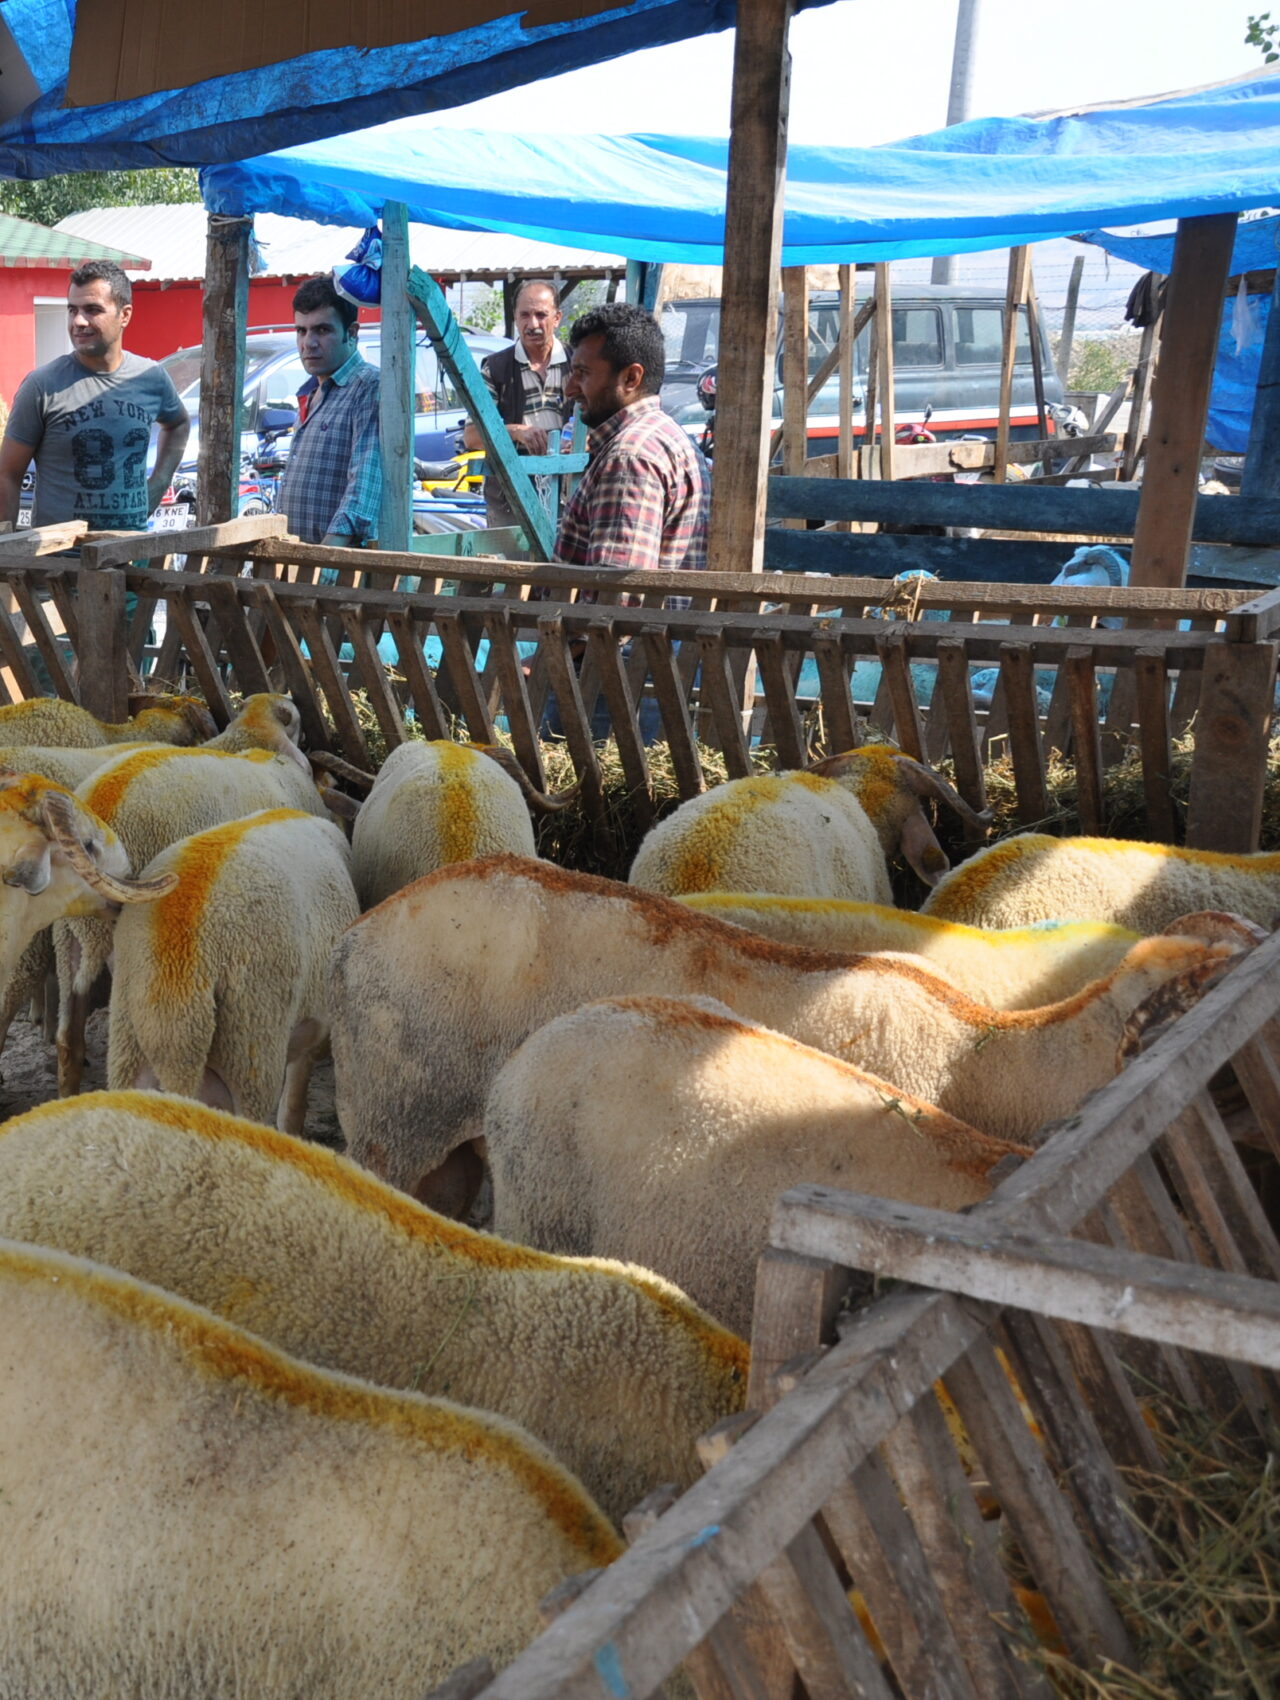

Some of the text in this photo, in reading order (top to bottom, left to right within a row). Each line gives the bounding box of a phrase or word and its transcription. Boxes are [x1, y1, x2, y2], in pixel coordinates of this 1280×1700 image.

[64, 400, 105, 431] NEW
[72, 428, 149, 490] 82
[74, 492, 146, 510] ALLSTARS
[164, 507, 184, 516] KNE
[162, 519, 176, 528] 30
